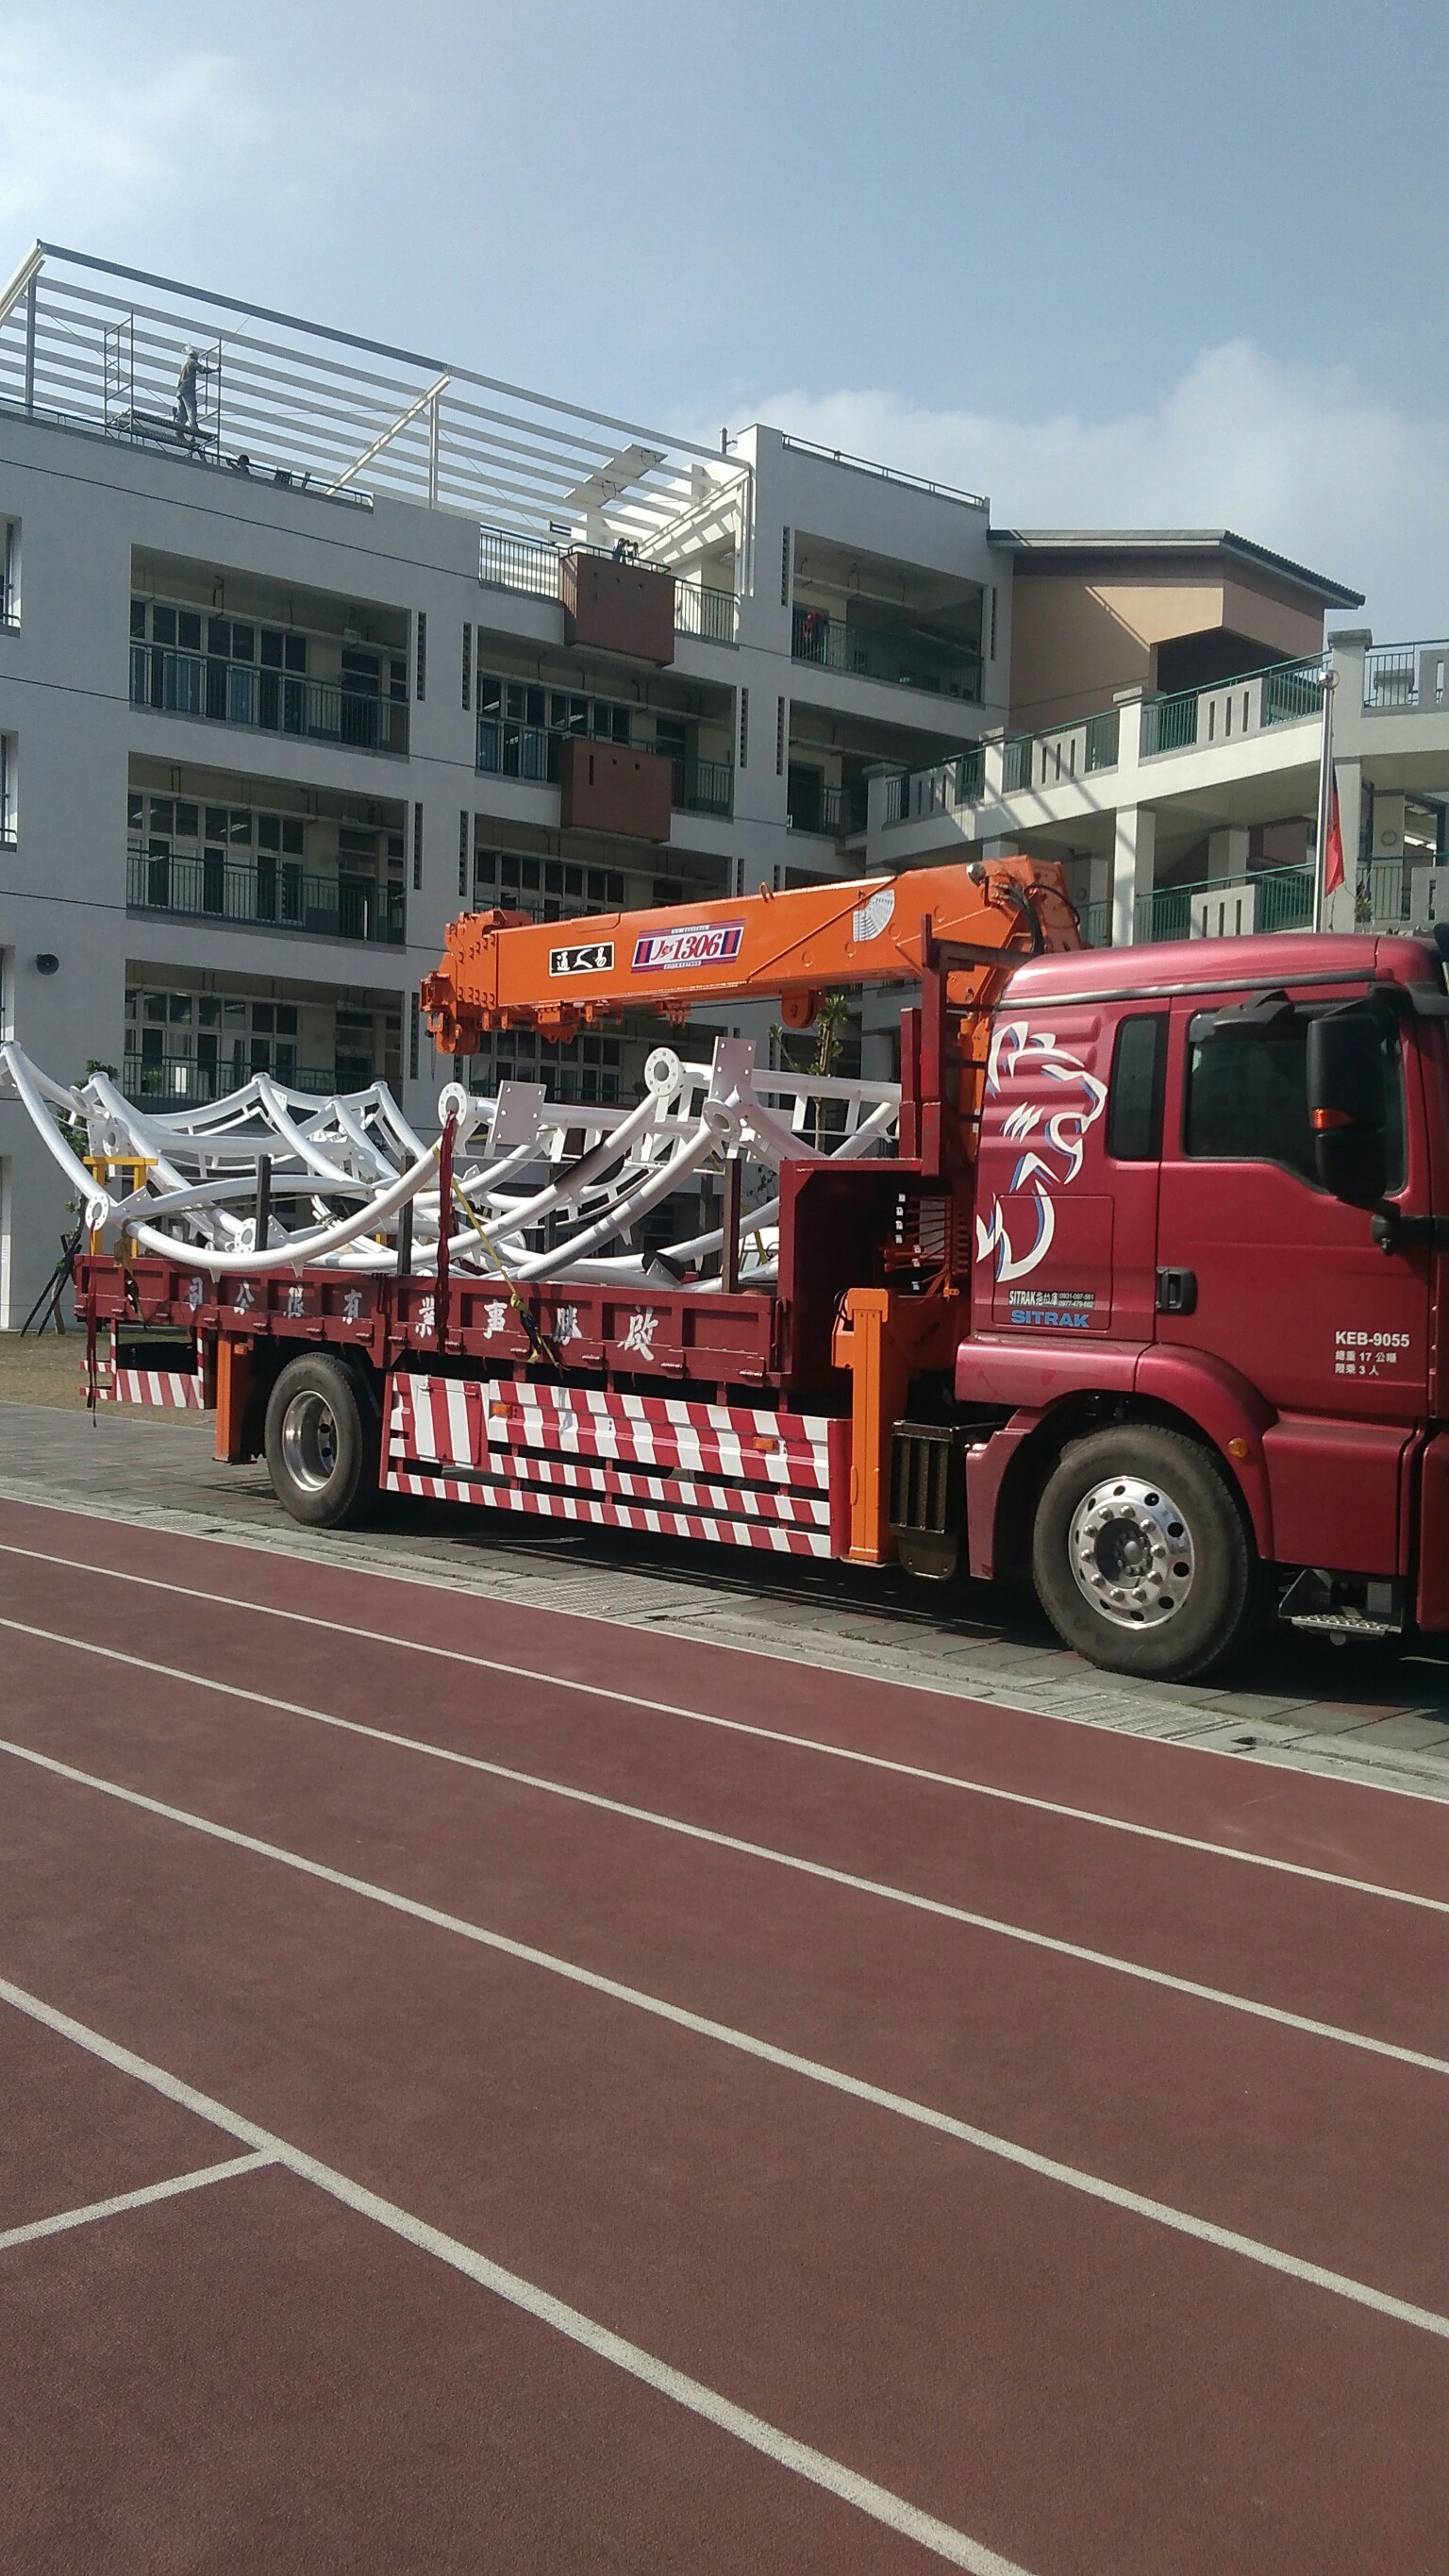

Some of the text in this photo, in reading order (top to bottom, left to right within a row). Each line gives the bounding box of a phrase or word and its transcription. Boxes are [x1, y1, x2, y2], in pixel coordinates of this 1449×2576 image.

[671, 933, 723, 961] 1306
[1011, 1310, 1090, 1328] SITRAK
[1335, 1330, 1410, 1347] KEB-9055
[1358, 1351, 1373, 1362] 17
[1358, 1365, 1366, 1375] 3
[1369, 1365, 1379, 1375] 人
